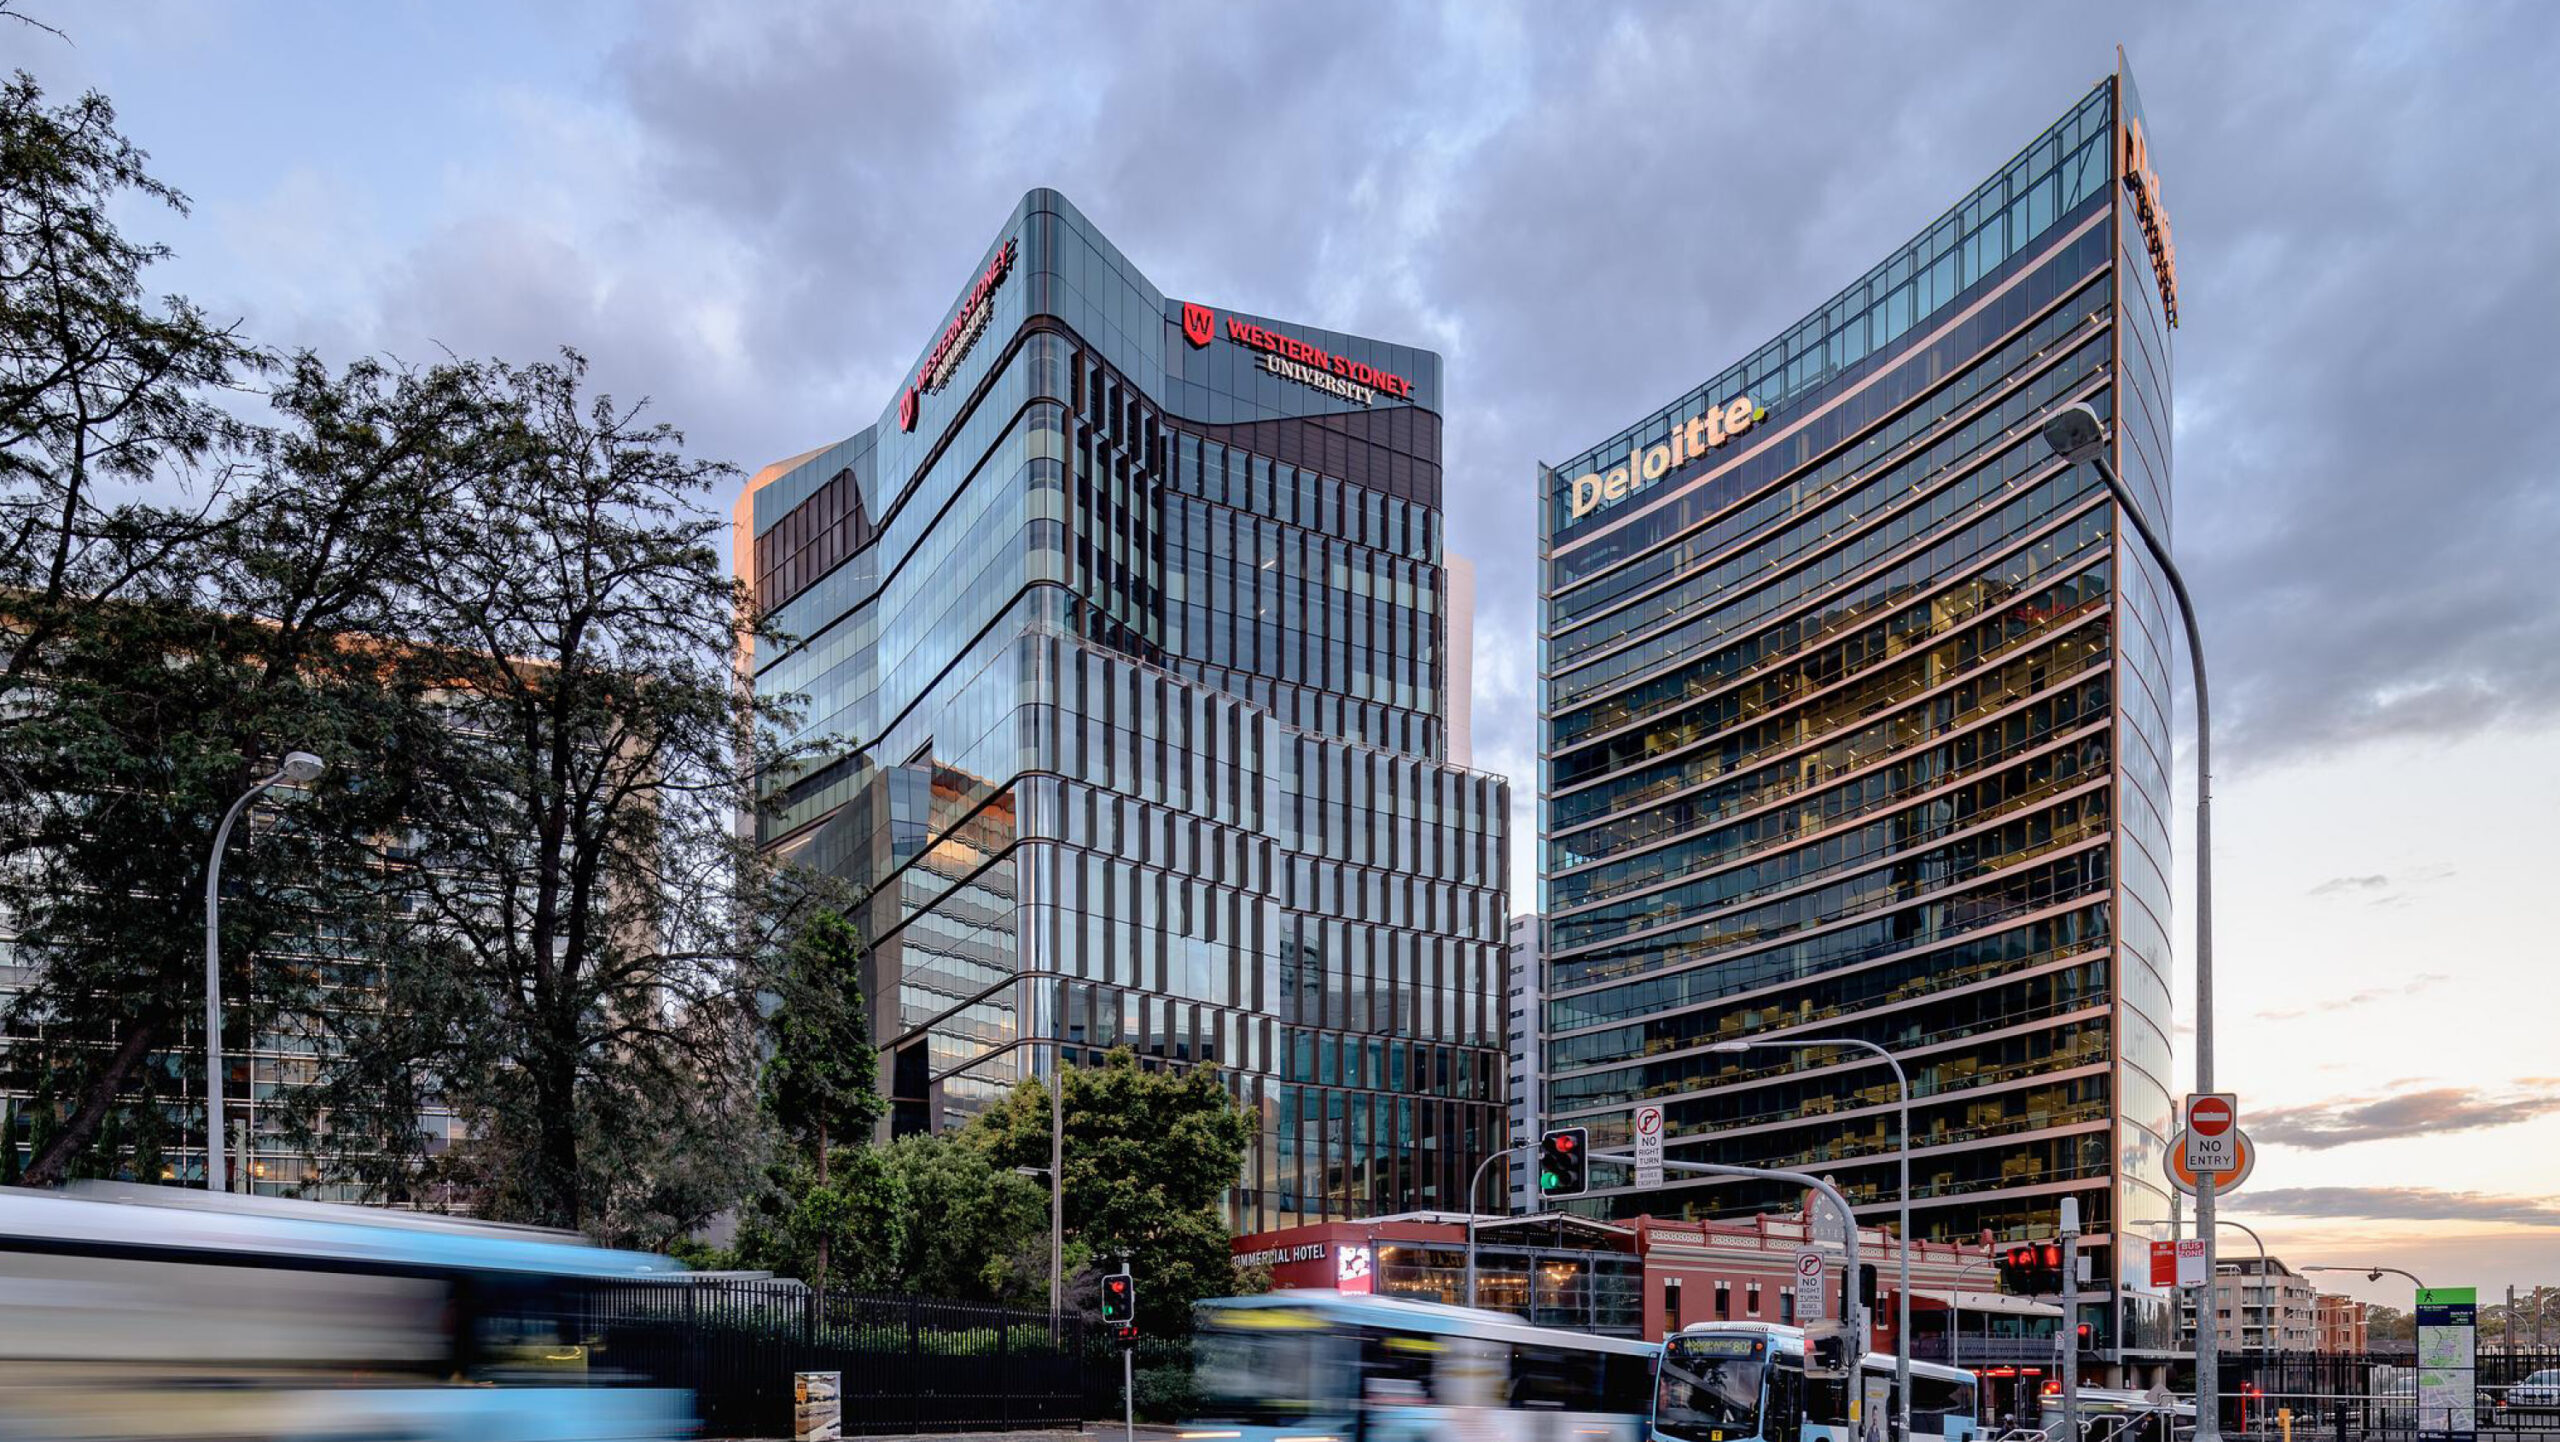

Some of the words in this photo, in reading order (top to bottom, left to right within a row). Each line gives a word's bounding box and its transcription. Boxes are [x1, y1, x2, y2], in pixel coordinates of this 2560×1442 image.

[917, 311, 964, 391] WESTERN
[965, 241, 1010, 317] SYDNEY
[932, 297, 990, 386] UNIVERSITY
[1227, 316, 1328, 371] WESTERN
[1333, 355, 1411, 397] SYDNEY
[1266, 354, 1376, 405] UNIVERSITY
[1642, 1136, 1657, 1146] NO
[2199, 1140, 2222, 1152] NO
[1639, 1148, 1659, 1156] RIGHT
[1639, 1157, 1659, 1166] TURN
[2189, 1155, 2231, 1166] ENTRY
[2181, 1242, 2201, 1250] BUS
[1293, 1243, 1326, 1262] HOTEL
[2179, 1250, 2204, 1258] ZONE
[1802, 1278, 1818, 1287] NO
